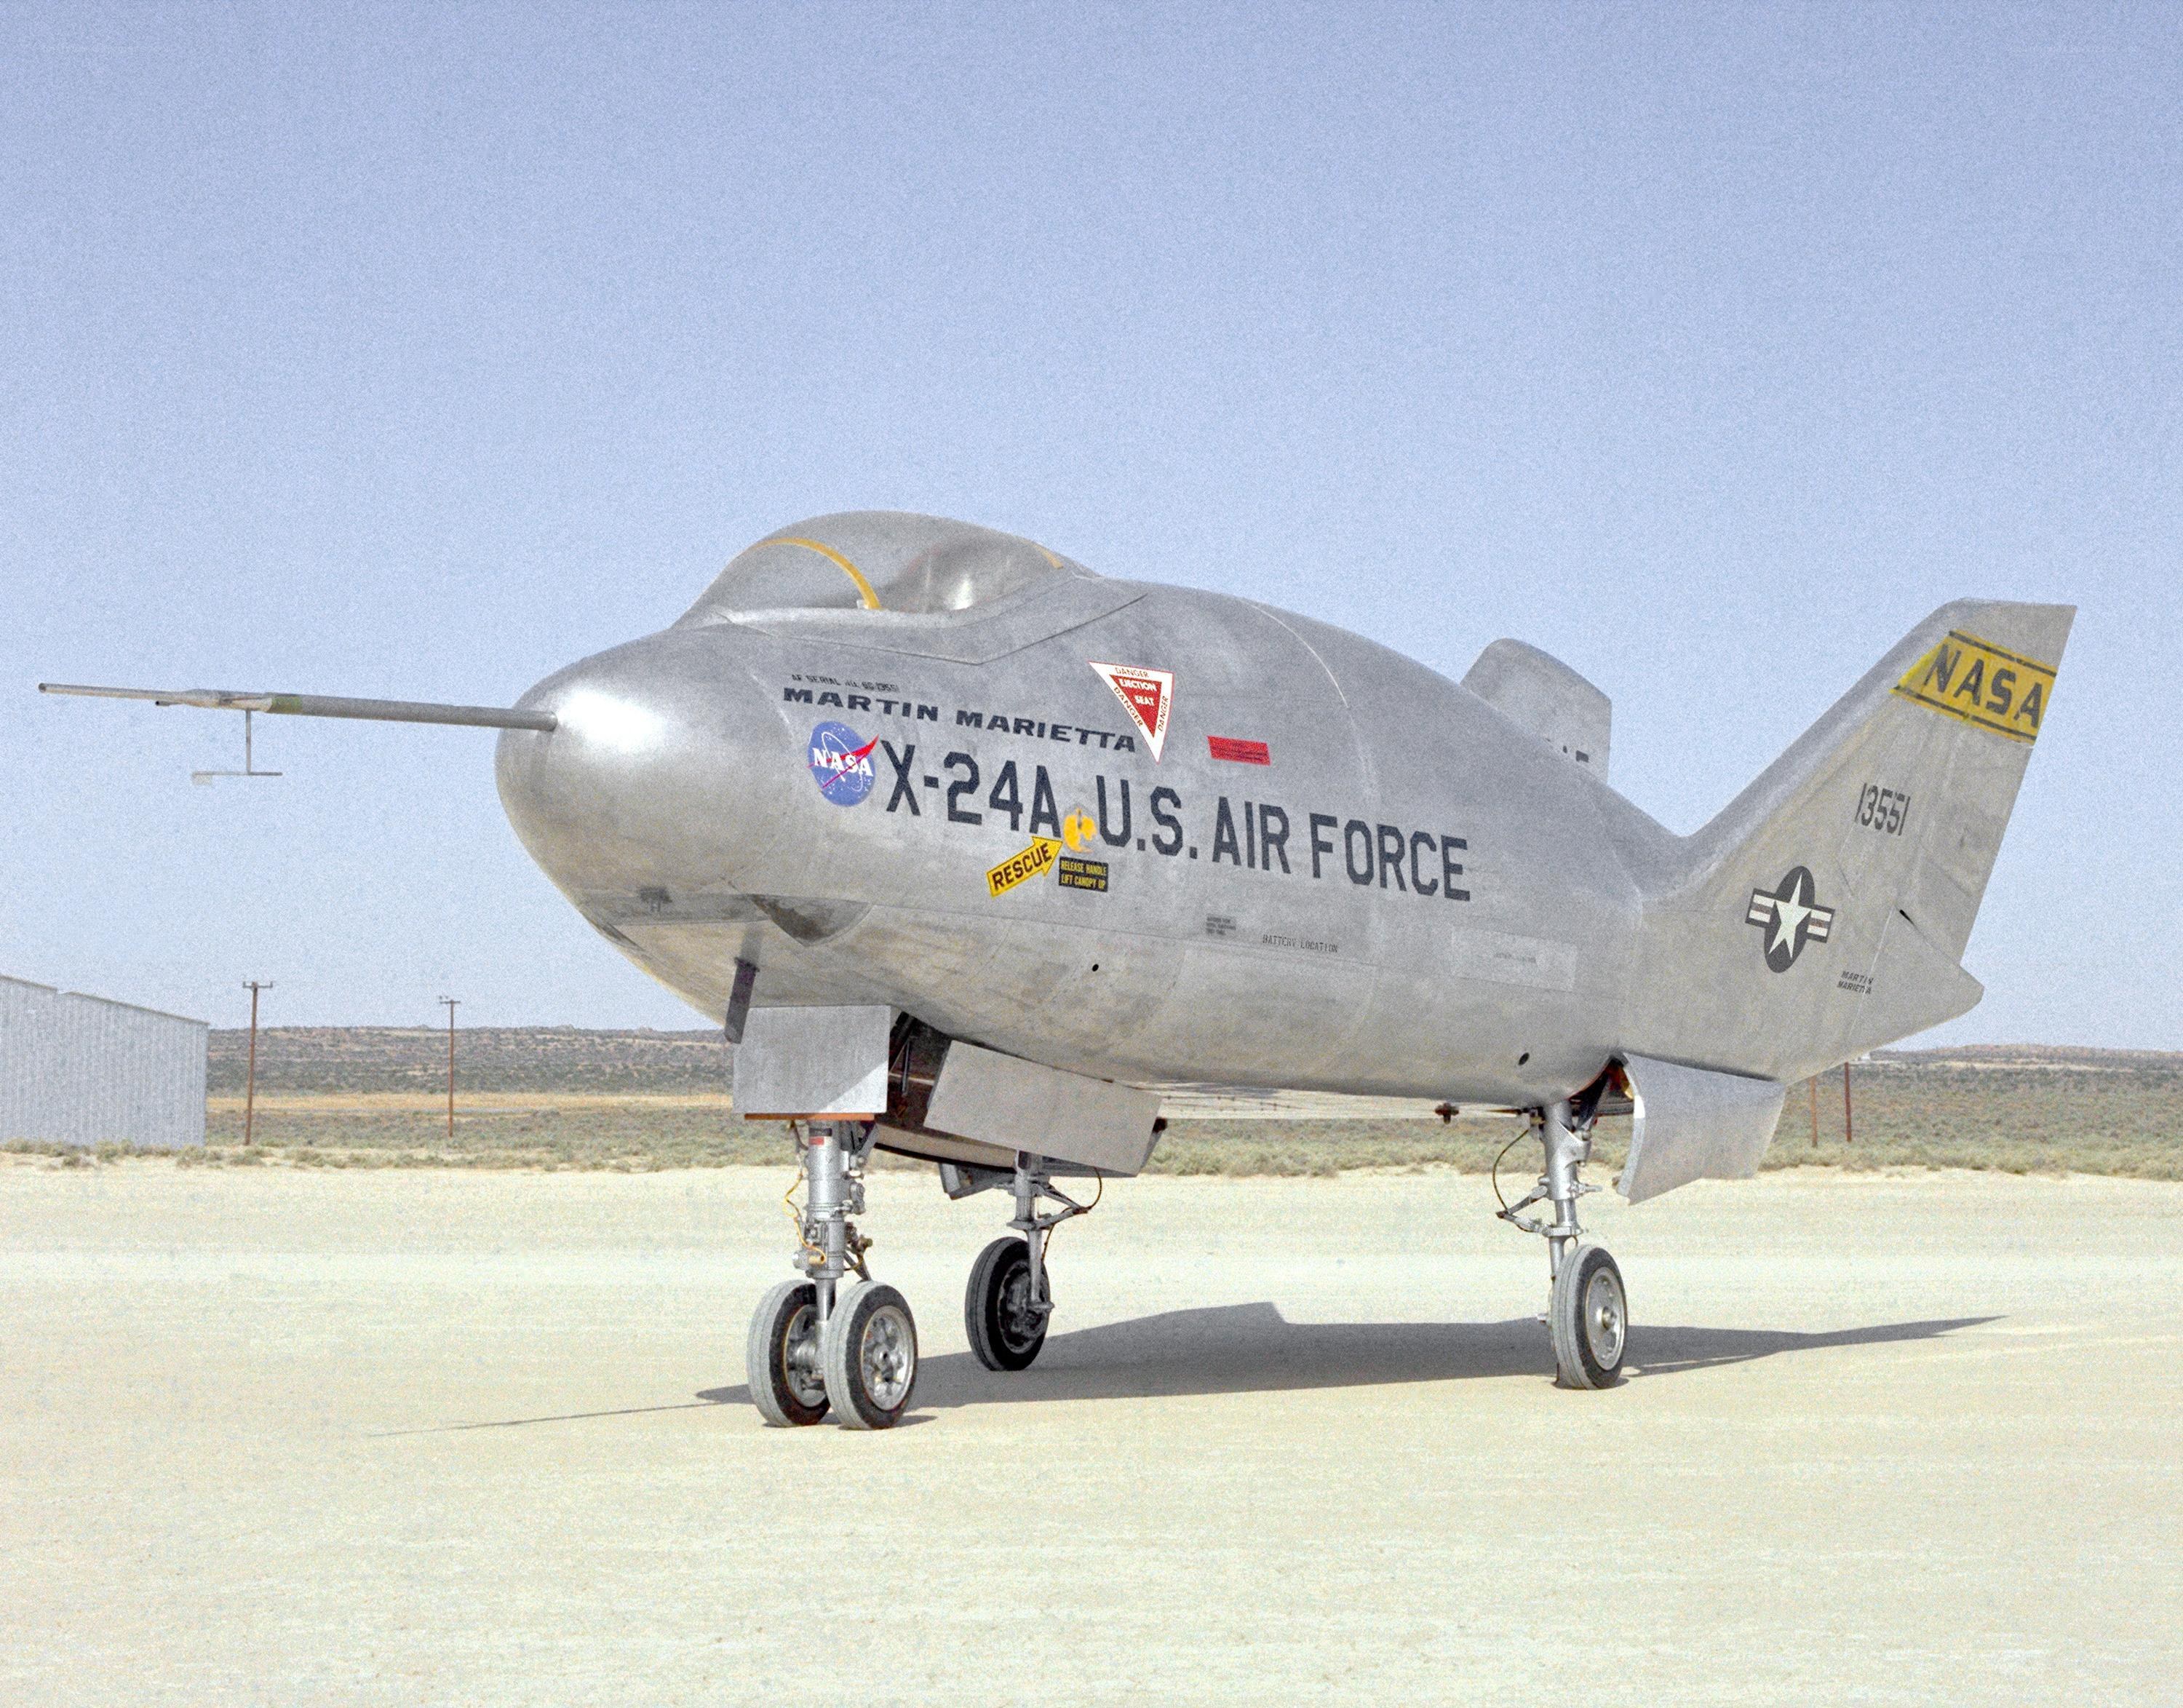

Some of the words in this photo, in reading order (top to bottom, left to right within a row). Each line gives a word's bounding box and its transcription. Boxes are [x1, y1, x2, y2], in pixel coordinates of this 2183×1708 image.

[806, 675, 841, 686] SERIAL
[1115, 667, 1150, 678] DANGER
[1118, 678, 1158, 691] EJECTION
[1924, 644, 2044, 727] NASA
[1114, 687, 1143, 726] DANGER
[1134, 695, 1155, 706] SEAT
[783, 688, 939, 721] MARTIN
[955, 710, 1136, 752] MARIETTA
[1158, 696, 1169, 731] DANGER
[812, 747, 874, 776] NASA
[1855, 783, 1911, 836] 13551
[880, 739, 1062, 838] X-24A
[1096, 775, 1198, 859] U.S.
[1212, 796, 1292, 874] AIR
[1309, 812, 1471, 902] FORCE
[992, 843, 1051, 891] RESCUE
[1061, 860, 1084, 873] RELEASE
[1086, 864, 1107, 876] HANDLE
[1061, 874, 1073, 885] LIFT
[1075, 875, 1097, 887] CANOPY
[1098, 880, 1106, 889] UP
[1263, 934, 1297, 948] BATTERY
[1300, 940, 1338, 953] LOCATION
[1841, 971, 1874, 984] MARTIN
[1837, 981, 1871, 994] MARIETTA
